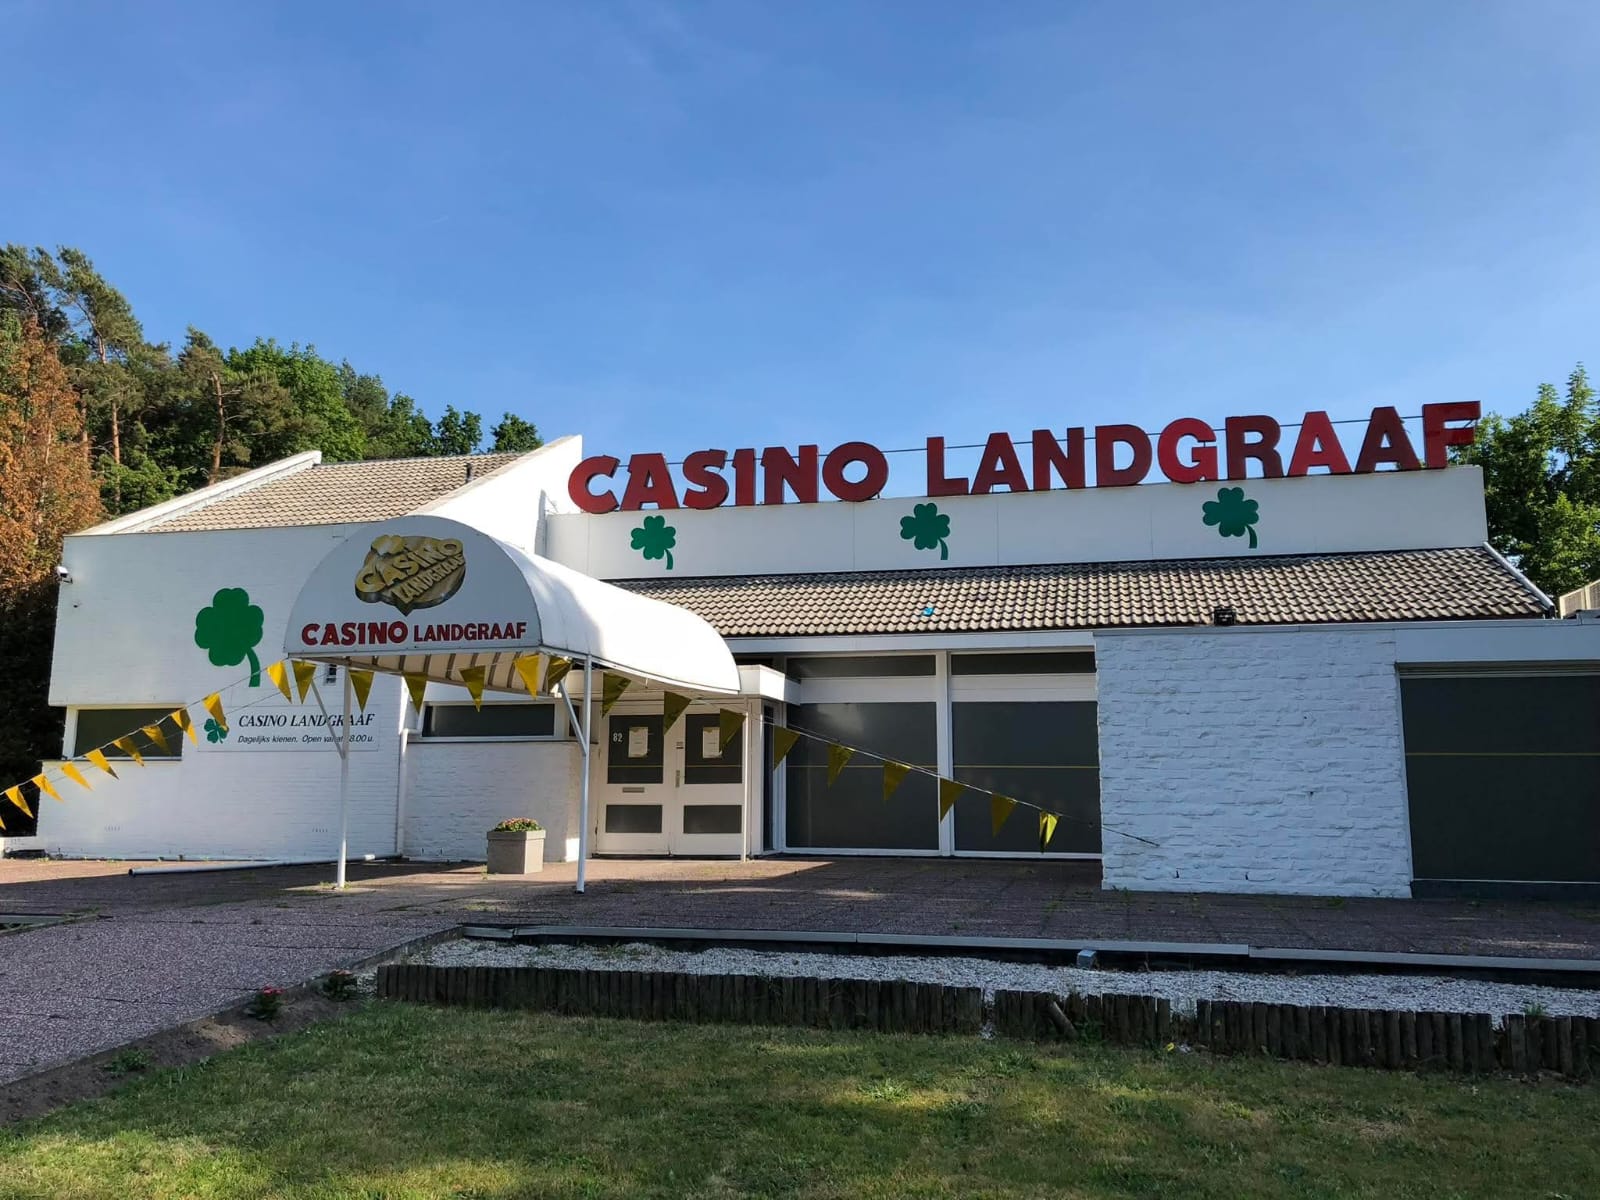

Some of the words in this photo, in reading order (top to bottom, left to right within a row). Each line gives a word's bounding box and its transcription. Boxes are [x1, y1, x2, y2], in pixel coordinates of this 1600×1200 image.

[568, 441, 888, 514] CASINO
[926, 401, 1481, 496] LANDGRAAF
[355, 538, 463, 593] CASINO
[391, 553, 465, 603] LANDGRAAF
[301, 621, 408, 646] CASINO
[413, 622, 527, 642] LANDGRAAF
[238, 714, 288, 728] CASINO
[237, 735, 270, 744] Dagelijks
[271, 735, 299, 743] kienen.
[302, 734, 322, 743] Open
[612, 732, 623, 742] 82
